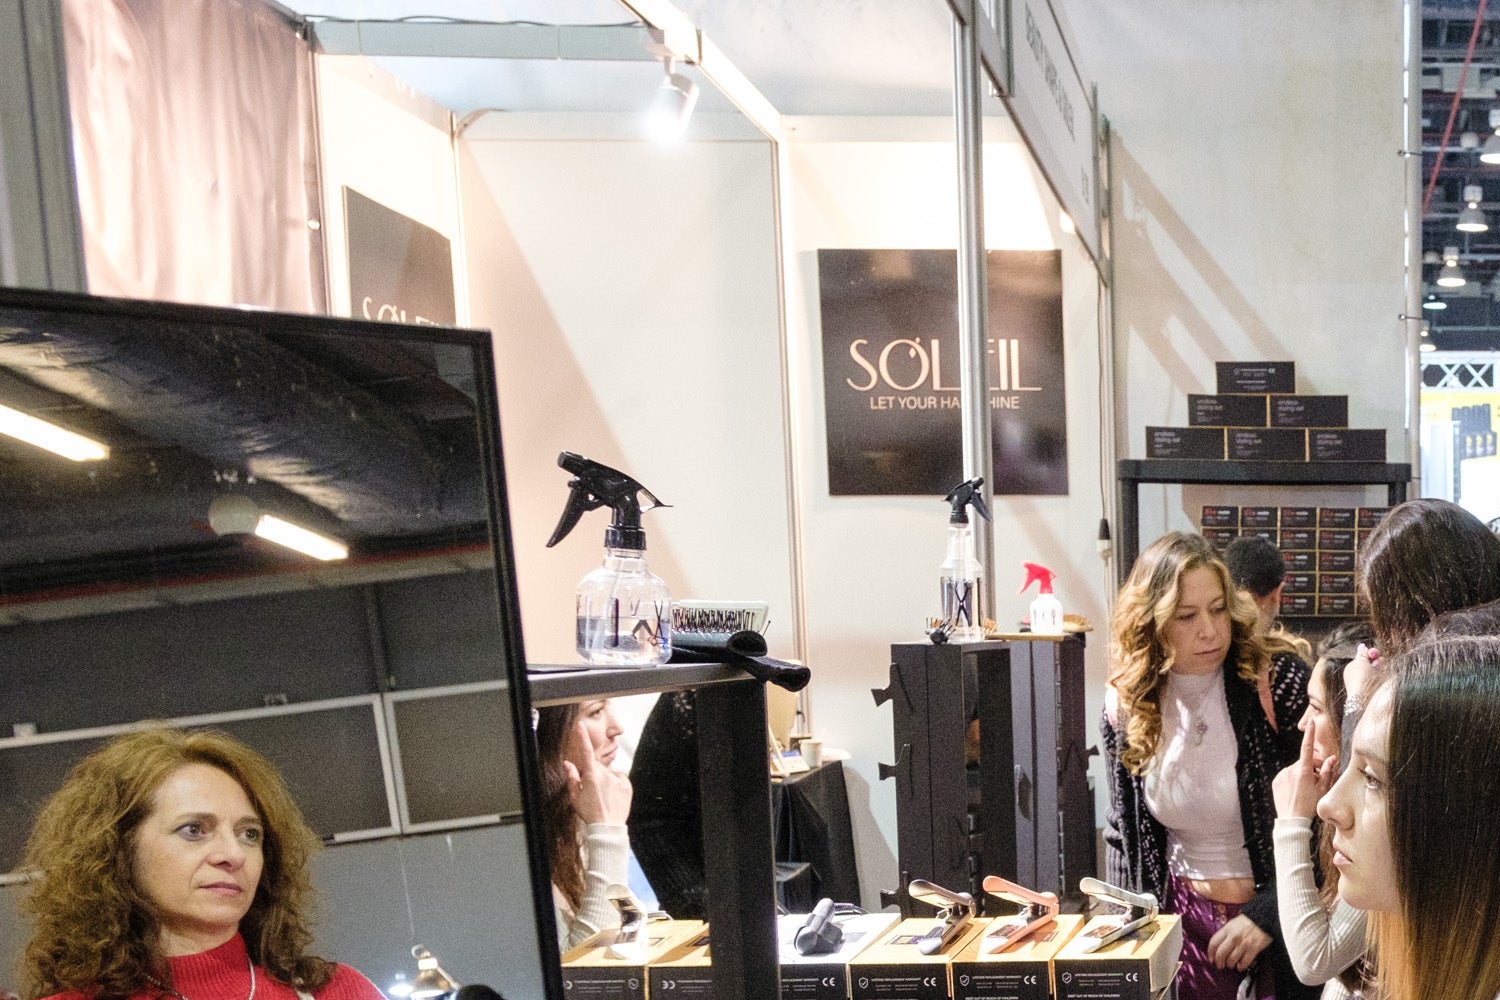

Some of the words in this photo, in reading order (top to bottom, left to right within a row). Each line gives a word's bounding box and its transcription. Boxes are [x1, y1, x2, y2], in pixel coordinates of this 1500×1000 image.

[870, 397, 896, 410] LET
[898, 396, 938, 409] YOUR
[941, 396, 961, 408] HA
[989, 396, 1020, 408] HINE
